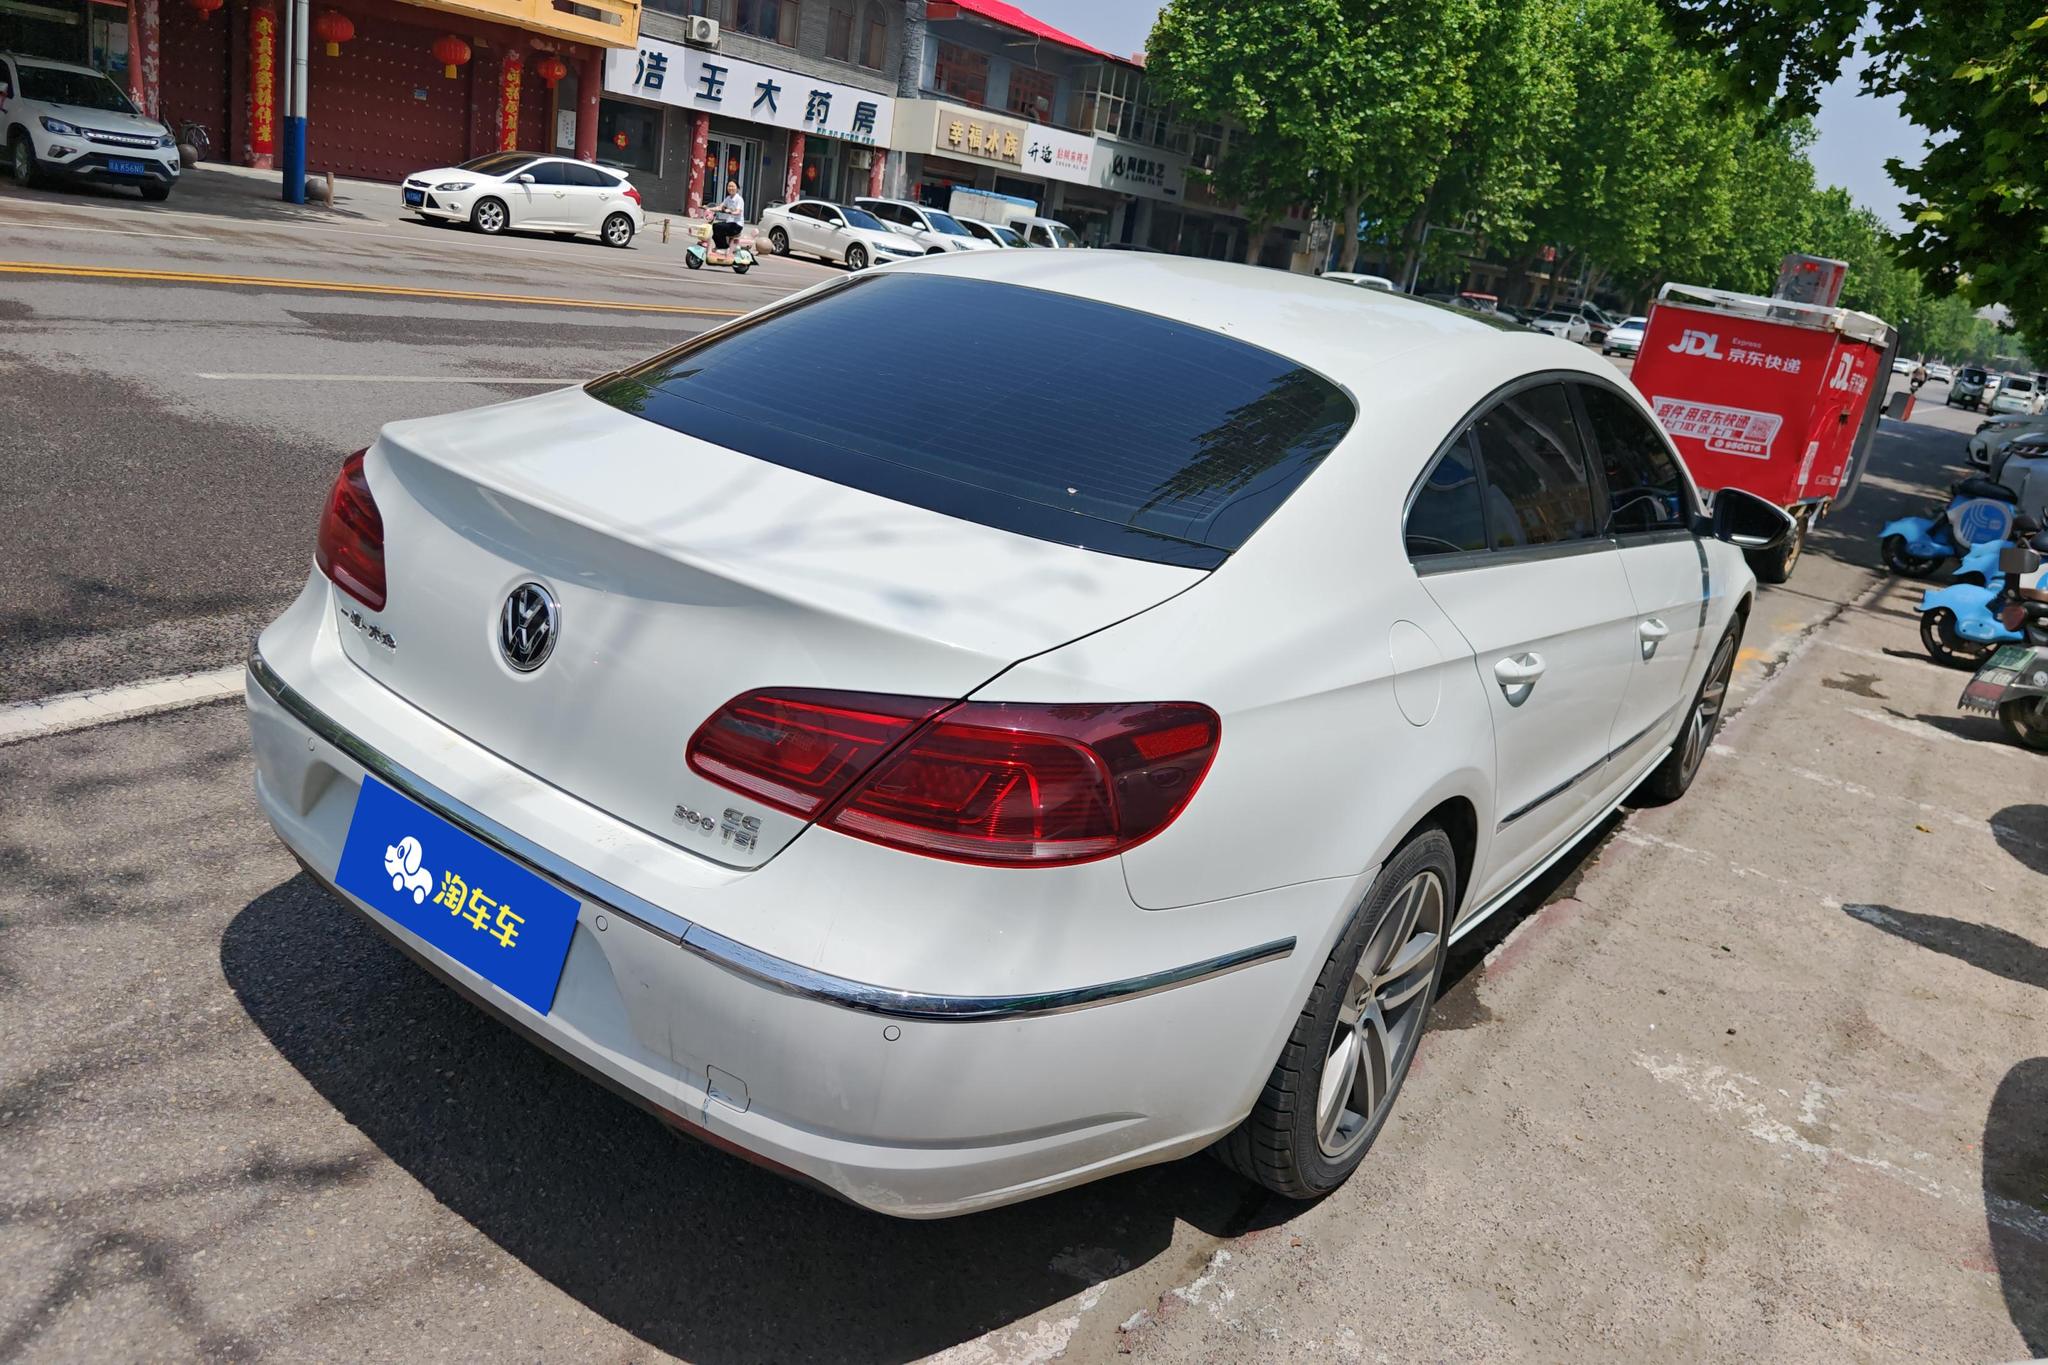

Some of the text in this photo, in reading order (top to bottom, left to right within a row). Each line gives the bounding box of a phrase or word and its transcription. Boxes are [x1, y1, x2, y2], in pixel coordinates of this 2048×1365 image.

[634, 50, 878, 134] 洁玉大药房
[949, 120, 1019, 158] 幸福水族
[1668, 329, 1723, 360] JDL
[1727, 347, 1801, 374] 京东快递
[674, 805, 758, 850] 300 TSI
[723, 807, 763, 833] CC
